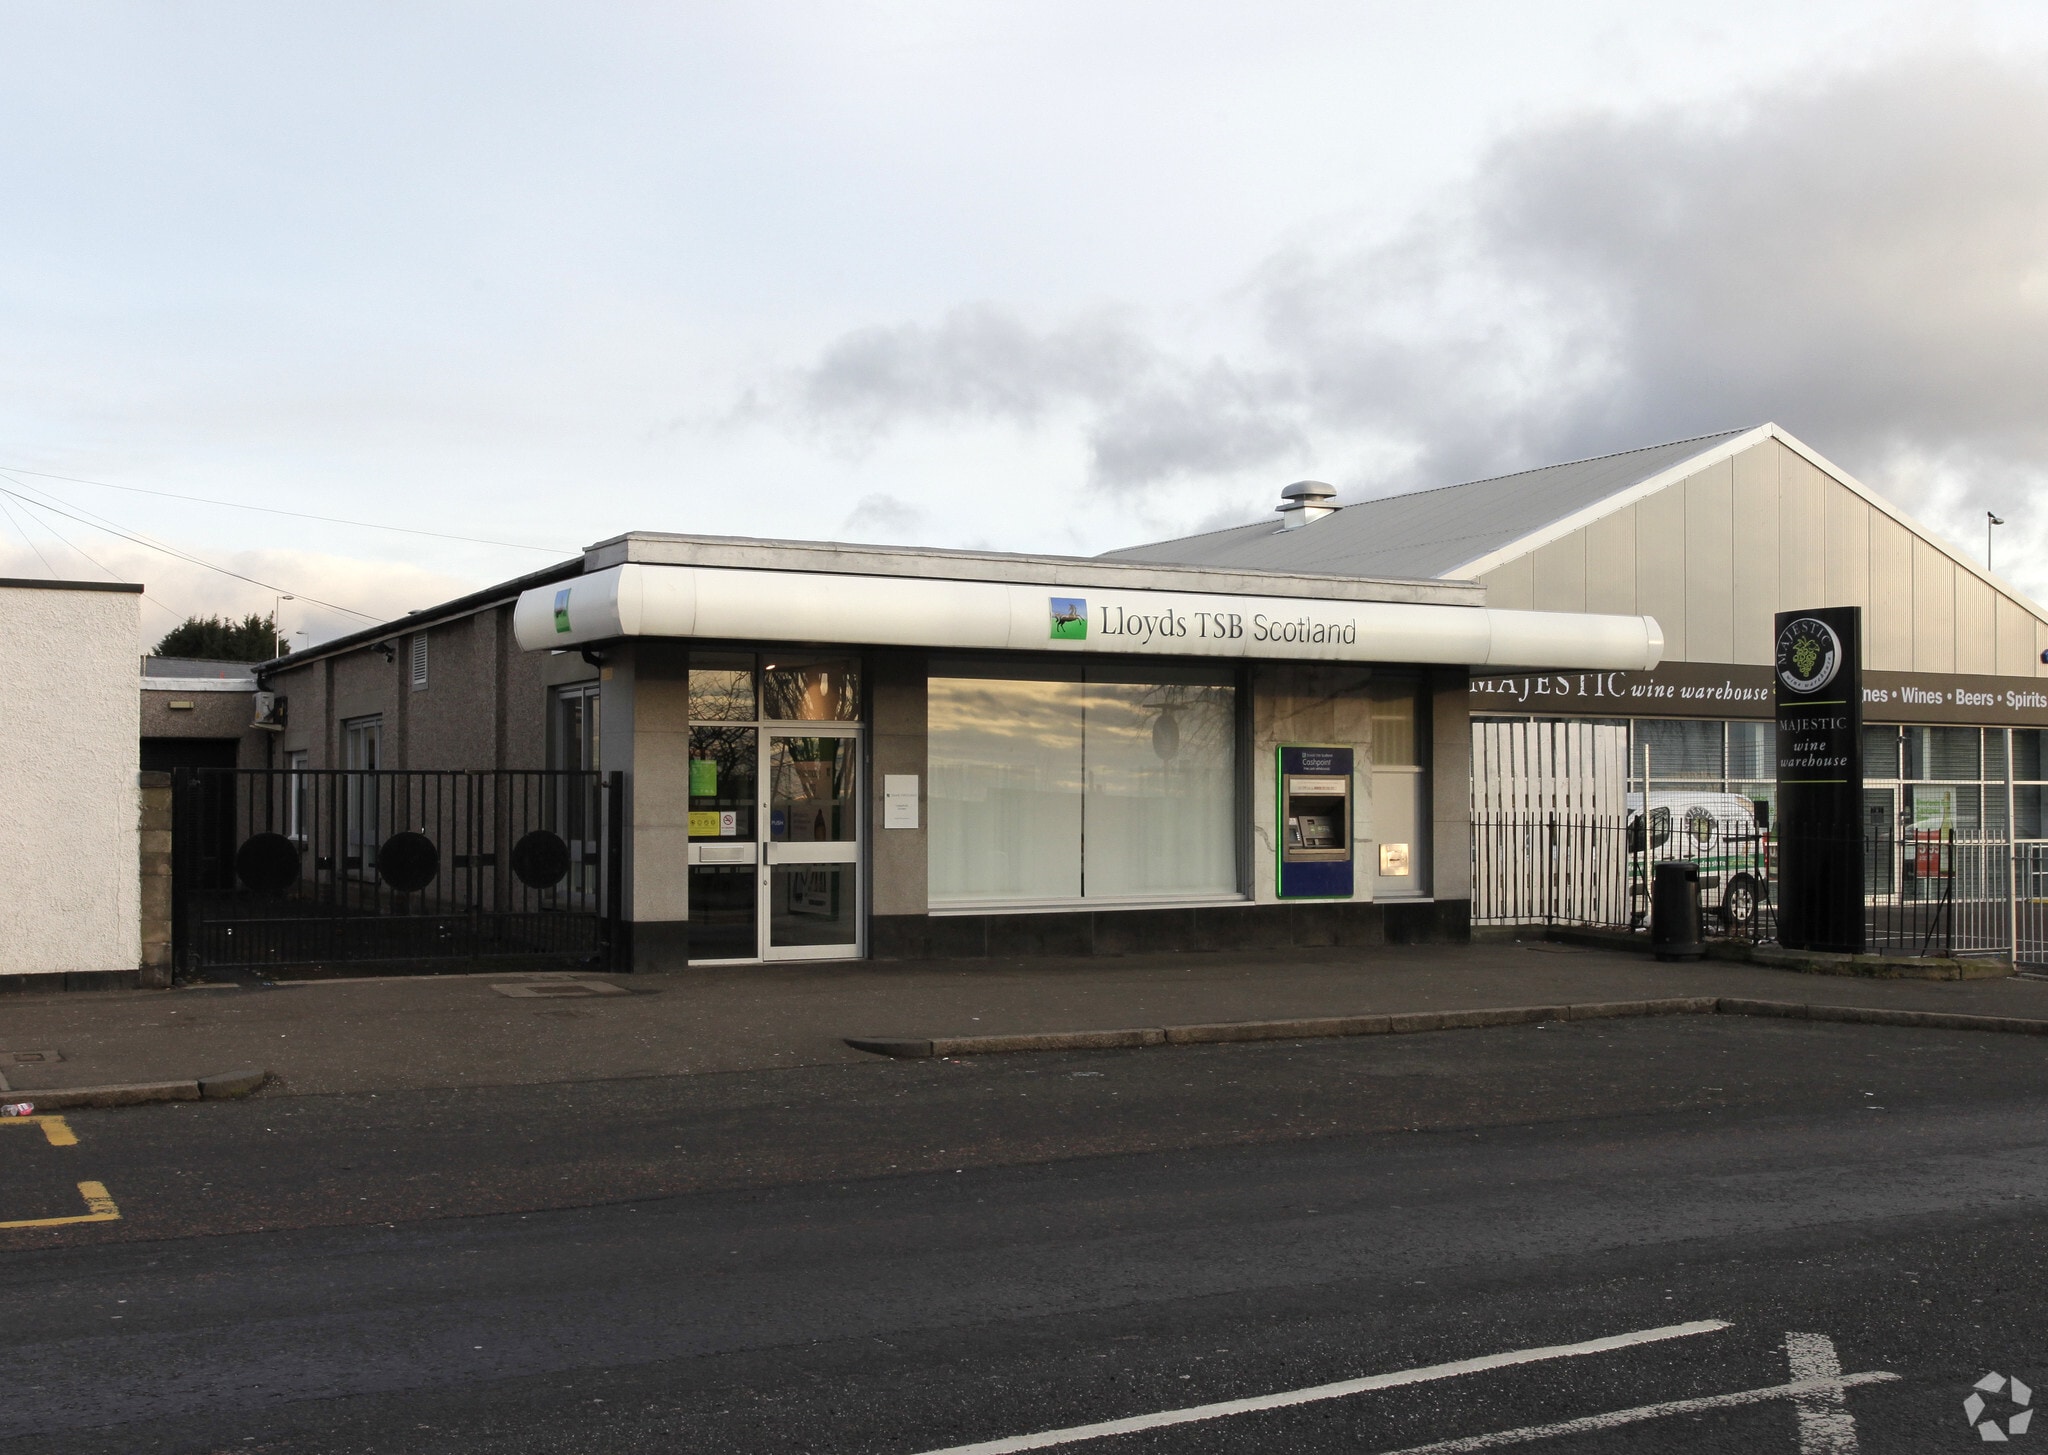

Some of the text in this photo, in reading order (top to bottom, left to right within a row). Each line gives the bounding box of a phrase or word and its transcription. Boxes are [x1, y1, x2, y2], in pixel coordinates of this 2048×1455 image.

[1100, 606, 1356, 645] Lloyds TSB Scotland
[1778, 621, 1831, 665] MAJESTIC
[1469, 672, 1768, 703] MAJESTIC wine warehouse
[1861, 686, 2048, 710] nes Wines Beers Spirits
[1779, 717, 1847, 734] MAJESTIC
[1793, 738, 1827, 751] wine
[1780, 753, 1848, 768] warehouse
